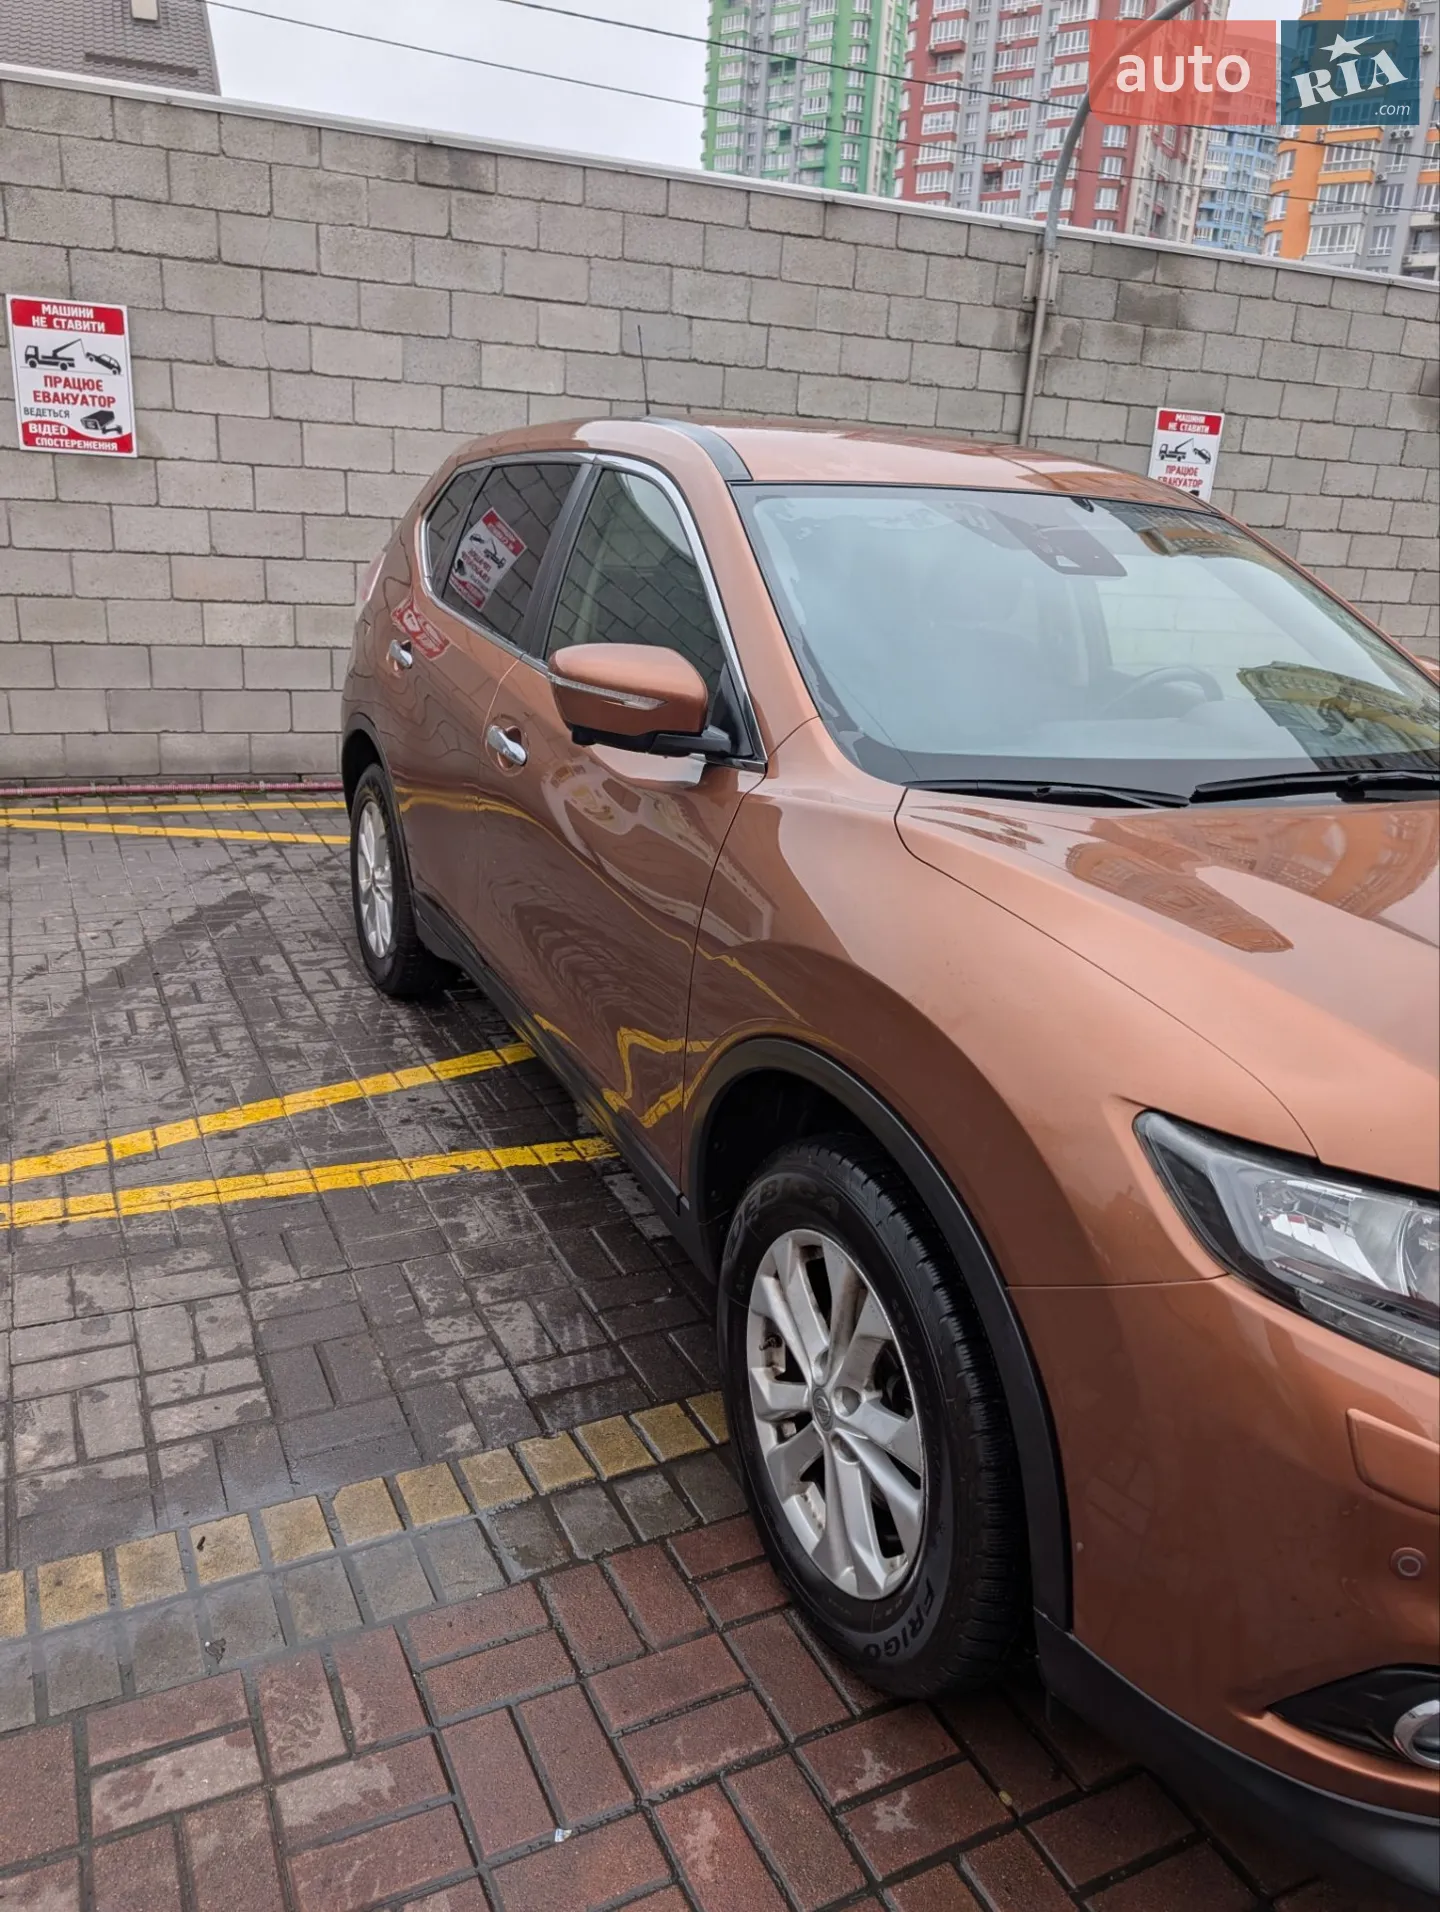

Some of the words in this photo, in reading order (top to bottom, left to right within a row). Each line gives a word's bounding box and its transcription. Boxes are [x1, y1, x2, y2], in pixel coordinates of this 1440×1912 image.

[41, 303, 94, 318] МАШИНИ
[32, 315, 48, 328] НЕ
[53, 317, 106, 333] СТАВИТИ
[43, 374, 104, 393] ПРАЦЮЄ
[33, 390, 116, 408] ЕВАКУАТОР
[23, 406, 70, 419] ВЕДЕТЬСЯ
[28, 422, 69, 436] ВІДЕО
[1168, 422, 1177, 431] НЕ
[1179, 423, 1210, 434] СТАВИТИ
[35, 436, 118, 451] СПОСТЕРЕЖЕННЯ
[1165, 465, 1198, 477] ПРАЦЮЄ
[863, 1576, 935, 1662] FRIGO
